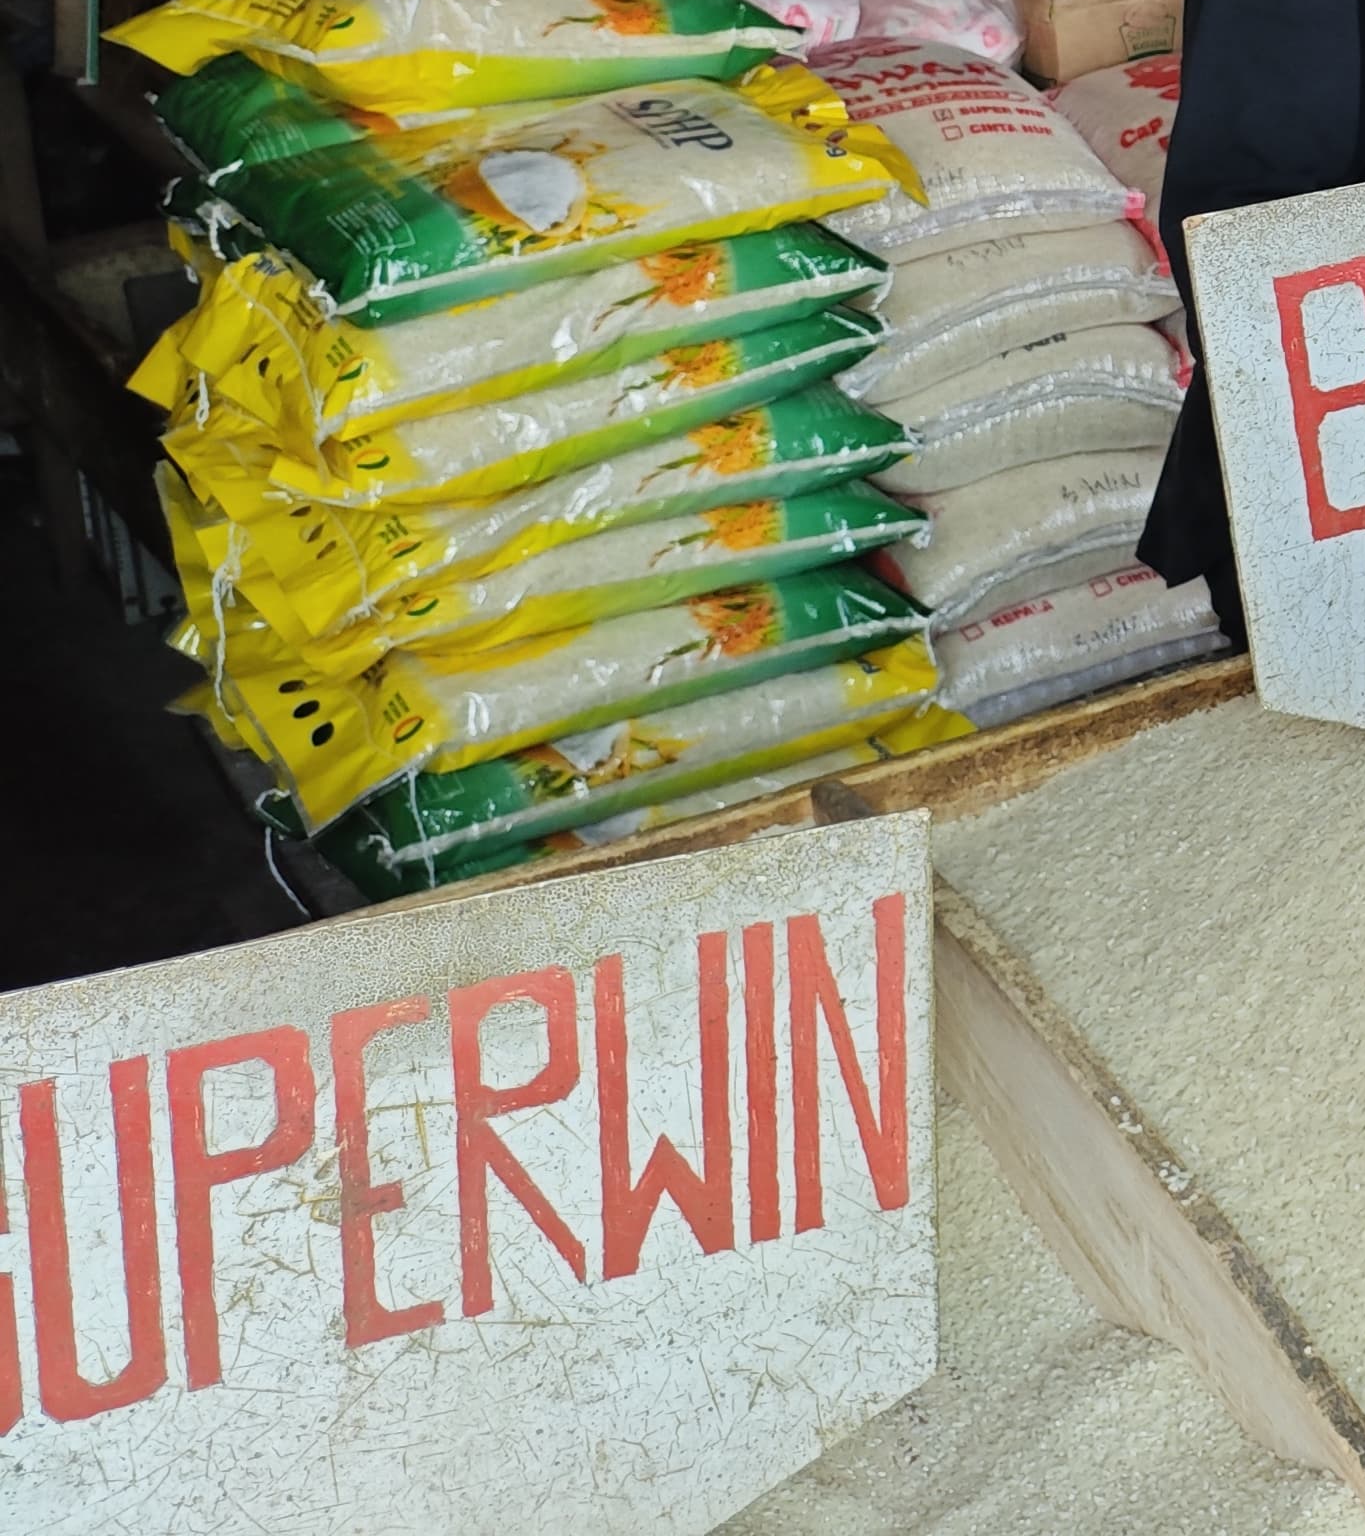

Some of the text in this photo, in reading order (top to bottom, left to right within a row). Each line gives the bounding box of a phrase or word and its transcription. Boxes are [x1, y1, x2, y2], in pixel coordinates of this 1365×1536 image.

[960, 105, 1009, 117] SUPER
[969, 124, 1017, 136] CINTA
[1120, 116, 1164, 149] CAP
[0, 892, 911, 1440] UPERWIN
